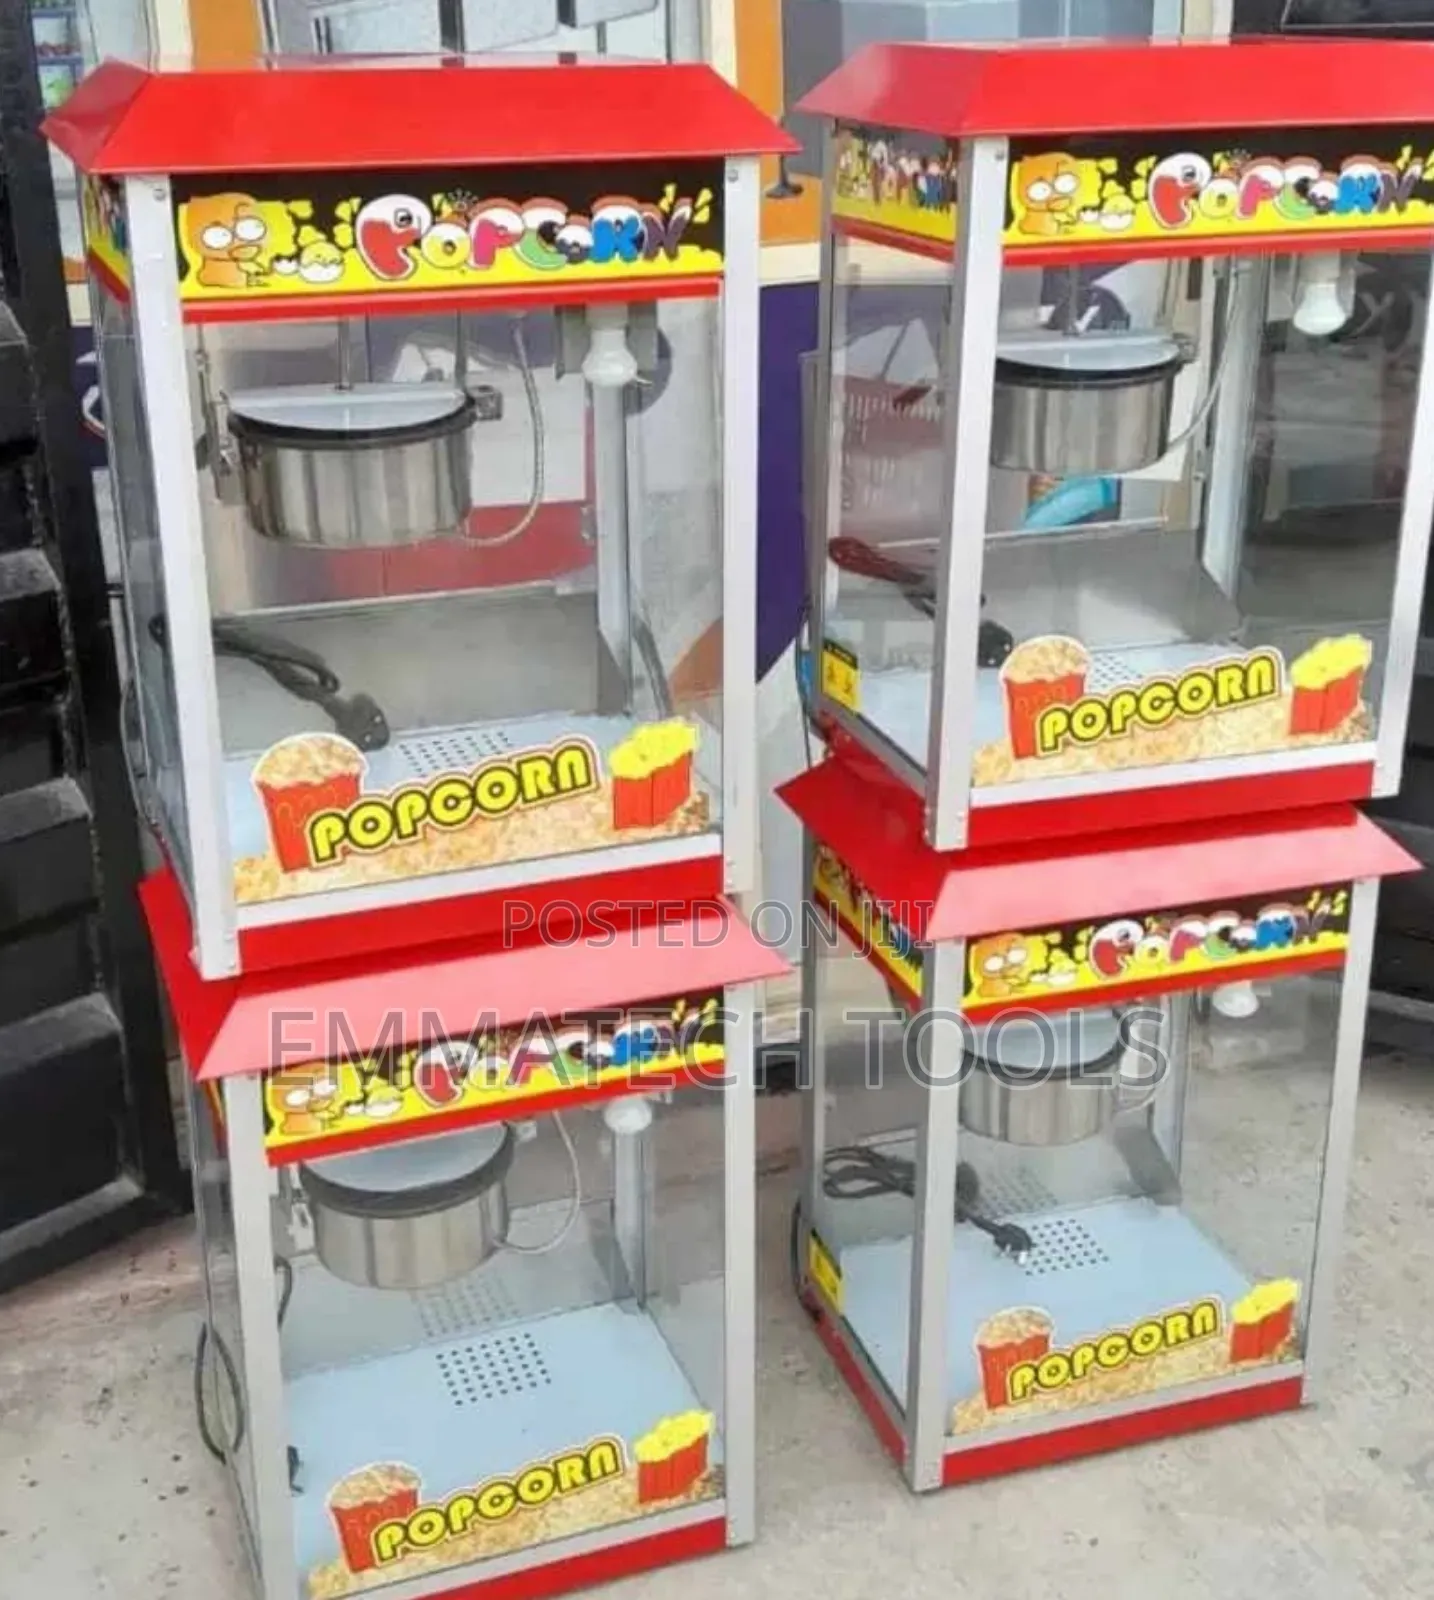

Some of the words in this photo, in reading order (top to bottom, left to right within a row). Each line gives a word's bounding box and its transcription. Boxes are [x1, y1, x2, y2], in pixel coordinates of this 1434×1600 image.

[356, 192, 692, 281] POPCORN
[1039, 653, 1277, 753] POPCORN
[308, 744, 594, 864] POPCORN
[1008, 1299, 1219, 1401] POPCORN
[373, 1440, 622, 1563] POPCORN
